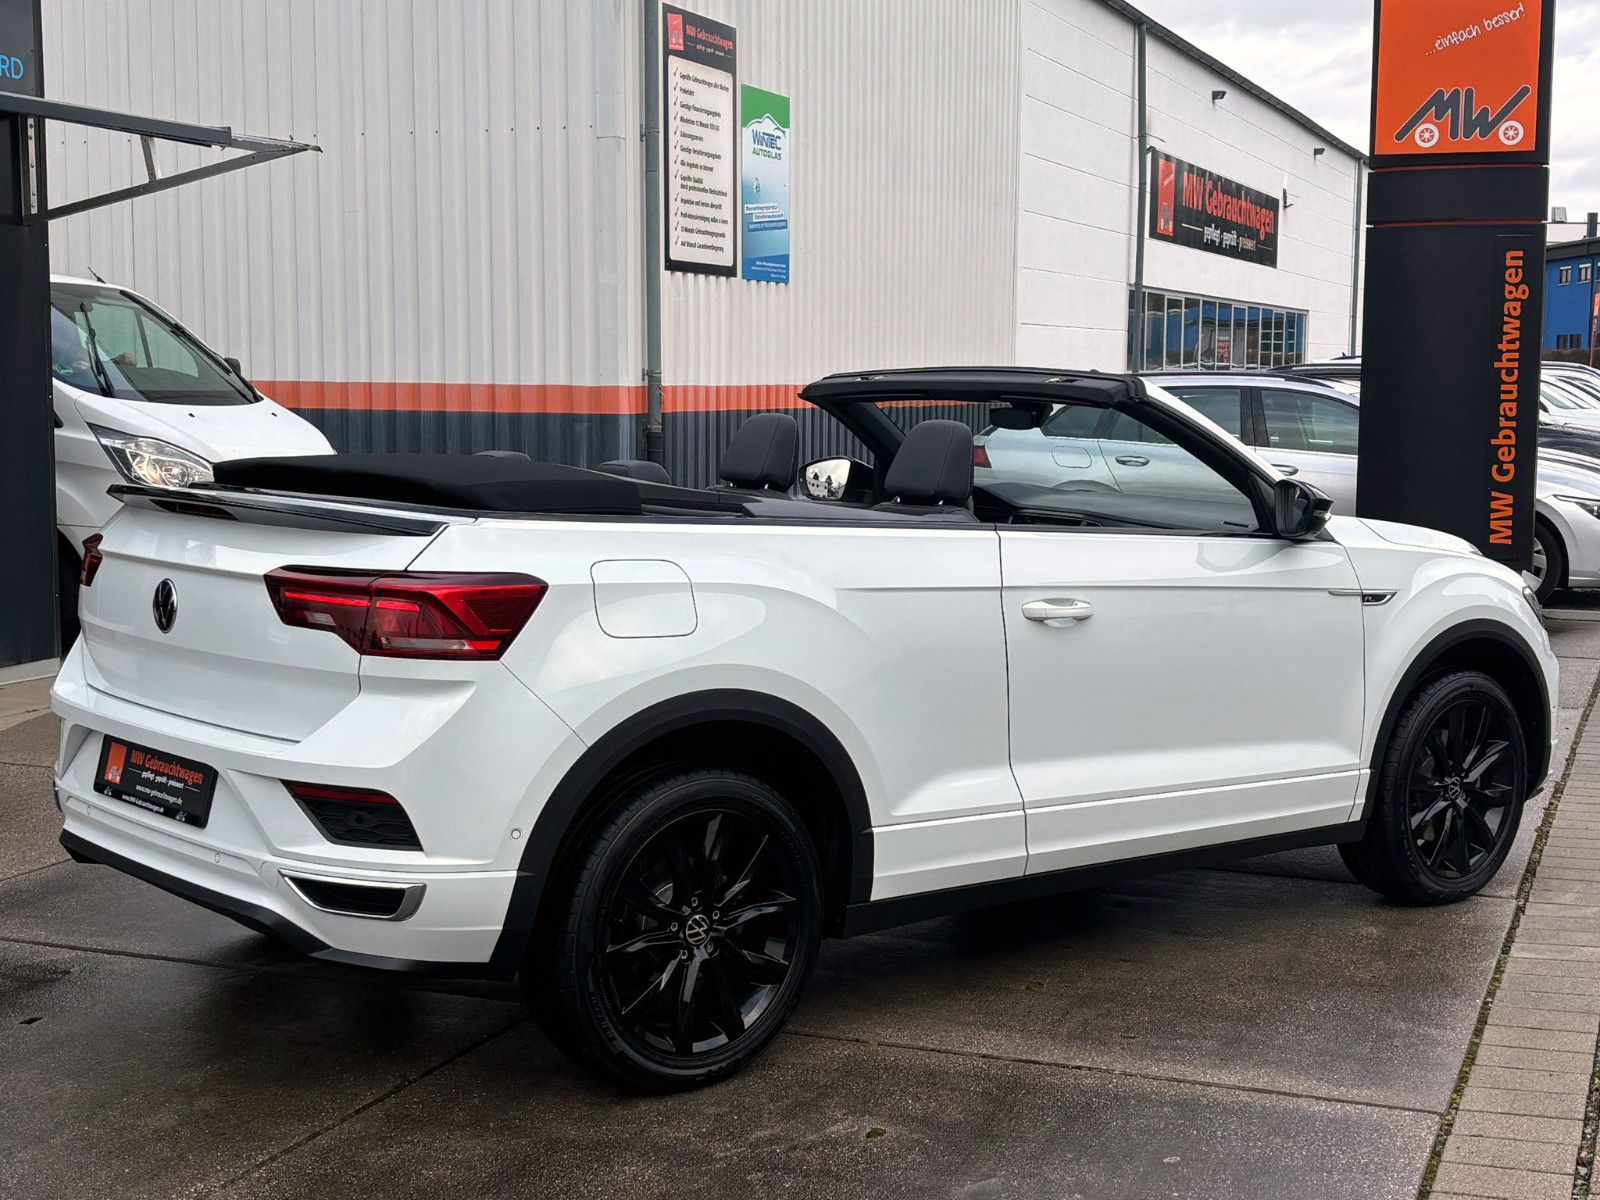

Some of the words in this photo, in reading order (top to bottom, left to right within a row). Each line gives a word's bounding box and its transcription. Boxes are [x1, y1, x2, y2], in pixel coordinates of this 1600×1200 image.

[1483, 2, 1526, 31] besser!
[1394, 85, 1532, 143] MW
[752, 147, 782, 161] AUTOGLAS
[1183, 171, 1204, 211] MW
[1205, 180, 1274, 240] Gebrauchtwagen
[1490, 249, 1530, 483] Gebrauchtwagen
[1489, 491, 1514, 545] MW
[130, 749, 145, 765] MW
[145, 753, 204, 785] Gebrauchtwagen
